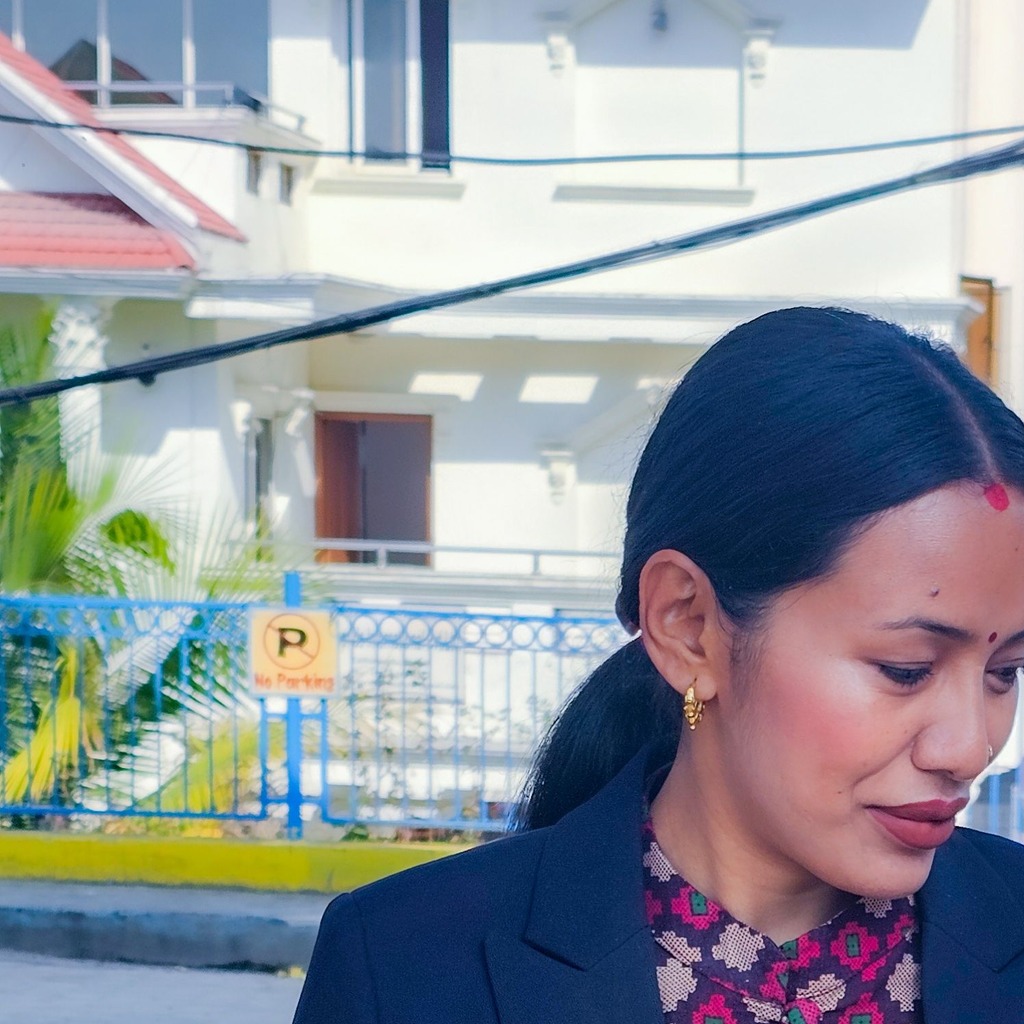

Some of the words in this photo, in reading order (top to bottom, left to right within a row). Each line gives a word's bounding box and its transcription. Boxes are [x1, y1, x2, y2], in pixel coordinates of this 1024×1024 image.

[278, 627, 306, 656] P
[254, 673, 272, 690] No
[277, 673, 334, 693] Parking
